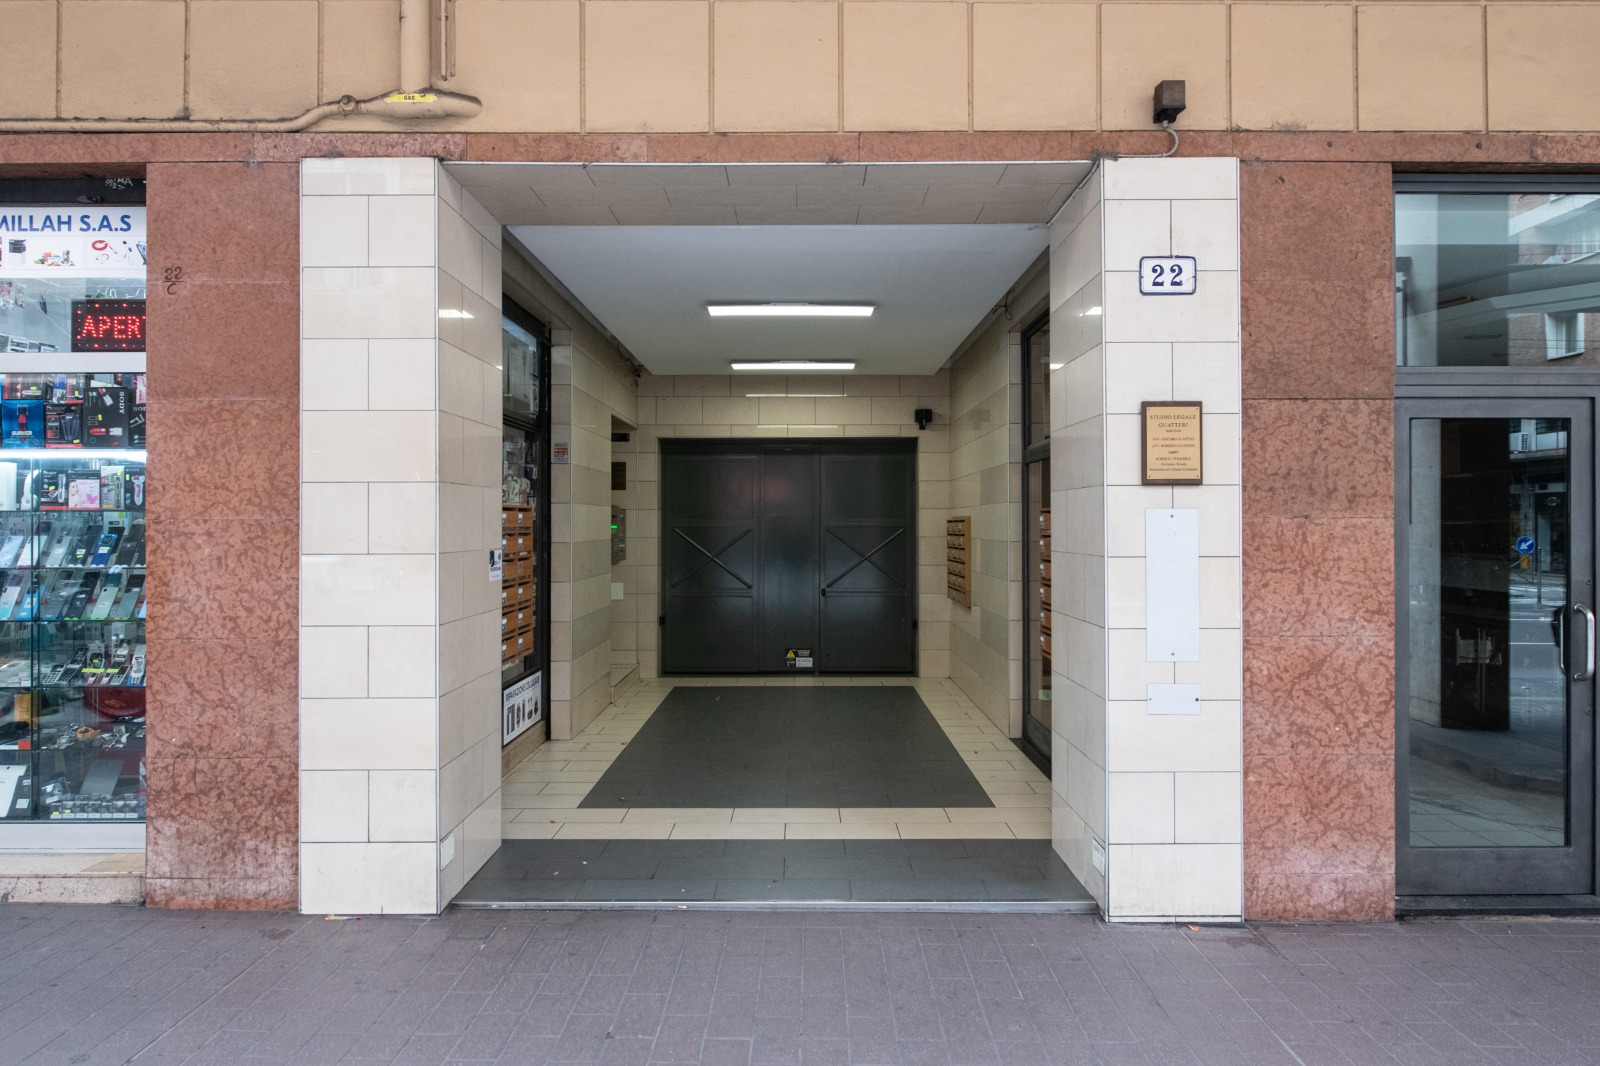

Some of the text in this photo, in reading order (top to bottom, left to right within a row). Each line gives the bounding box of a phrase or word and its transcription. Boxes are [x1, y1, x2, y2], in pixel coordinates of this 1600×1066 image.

[79, 214, 132, 232] S.A.S
[164, 266, 183, 281] 22
[1151, 264, 1183, 286] 22
[167, 282, 178, 295] C
[82, 316, 146, 338] APER
